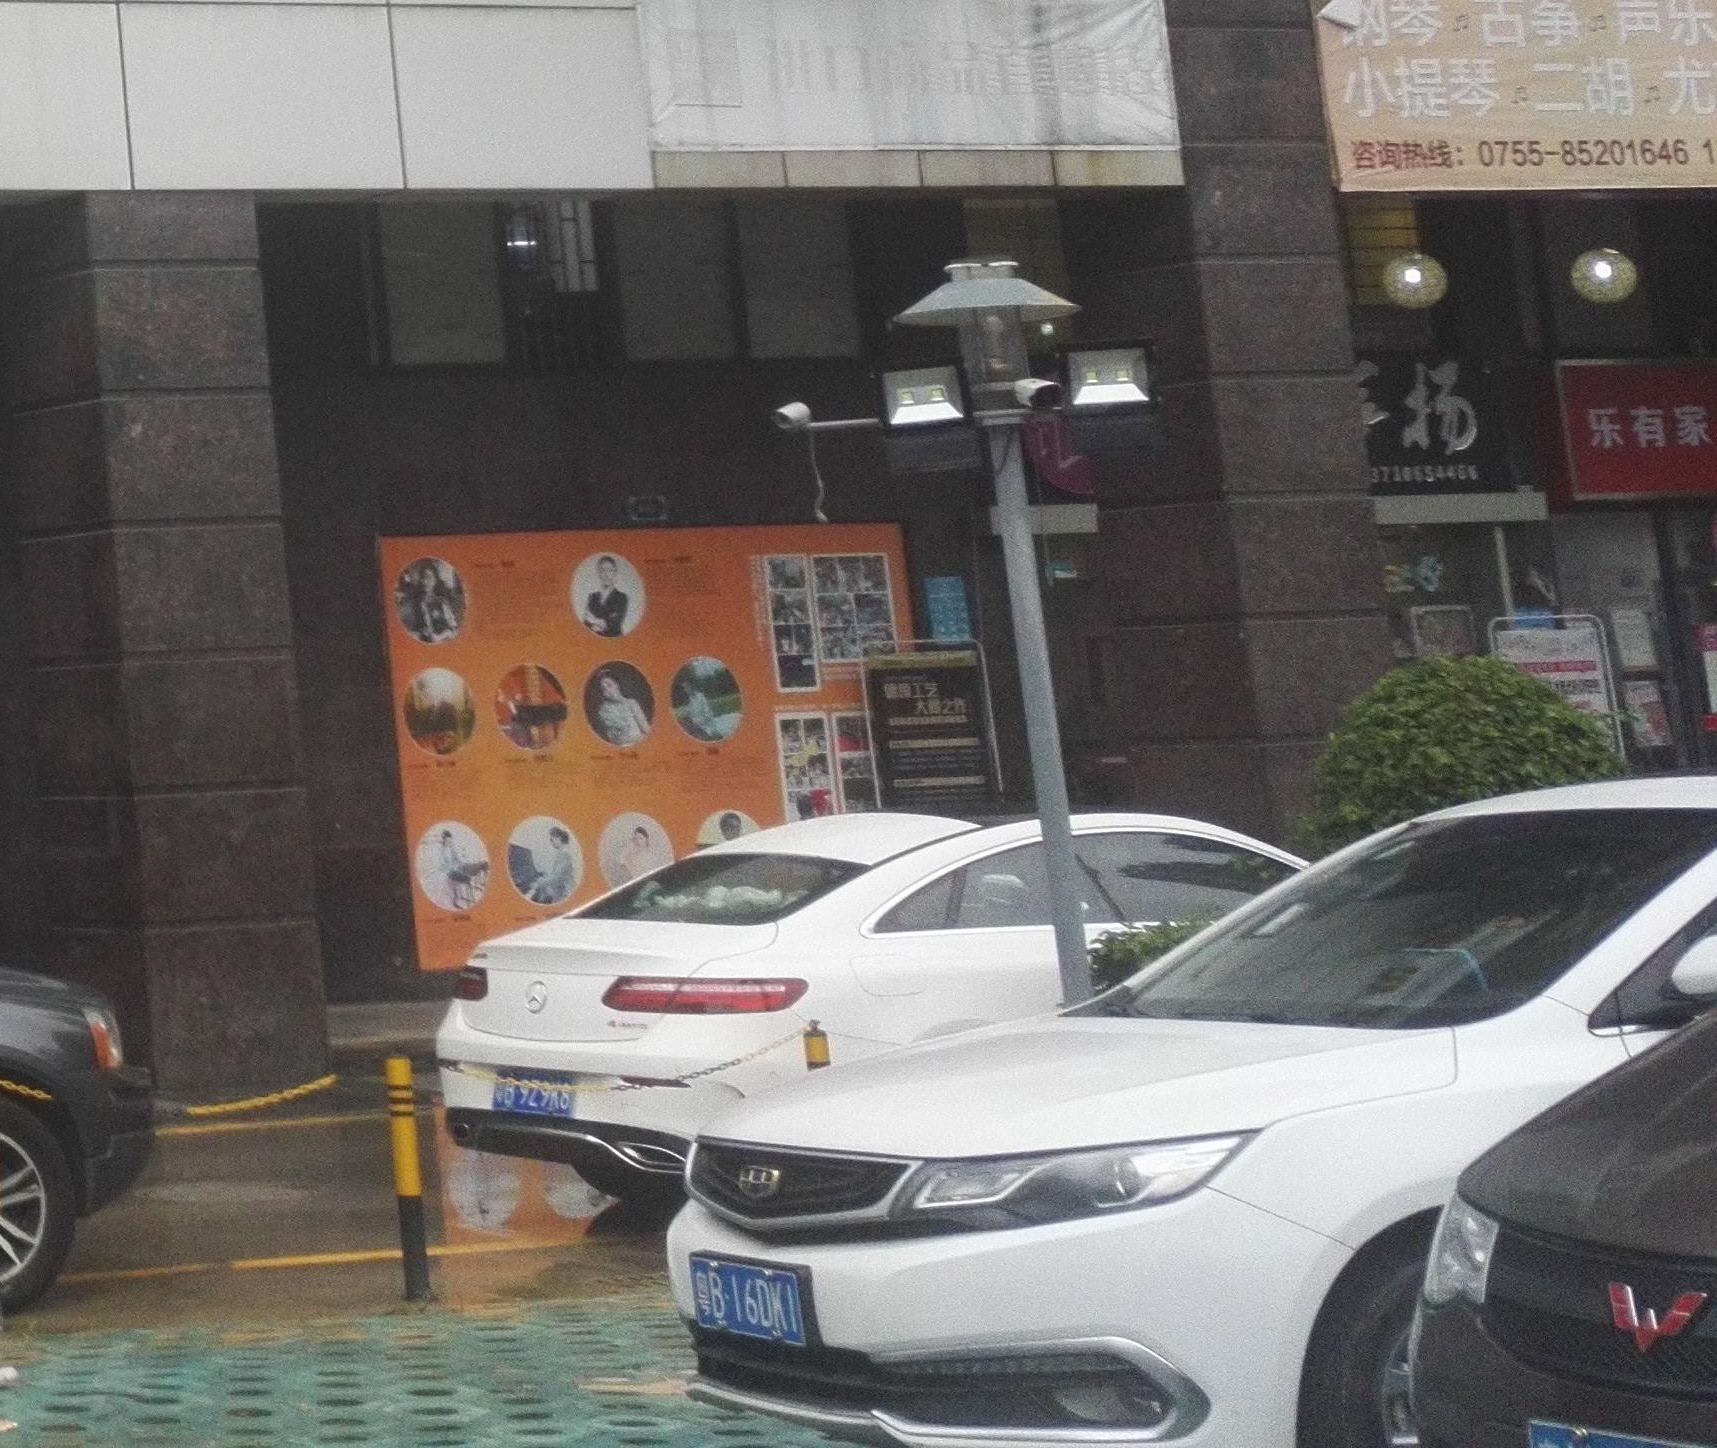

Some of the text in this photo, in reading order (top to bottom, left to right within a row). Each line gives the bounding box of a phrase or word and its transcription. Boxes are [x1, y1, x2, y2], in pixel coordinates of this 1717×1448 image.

[1344, 55, 1500, 118] 小提琴
[1532, 56, 1635, 117] 二胡
[1479, 138, 1690, 168] 0755-85201646
[1587, 405, 1712, 449] 乐有家
